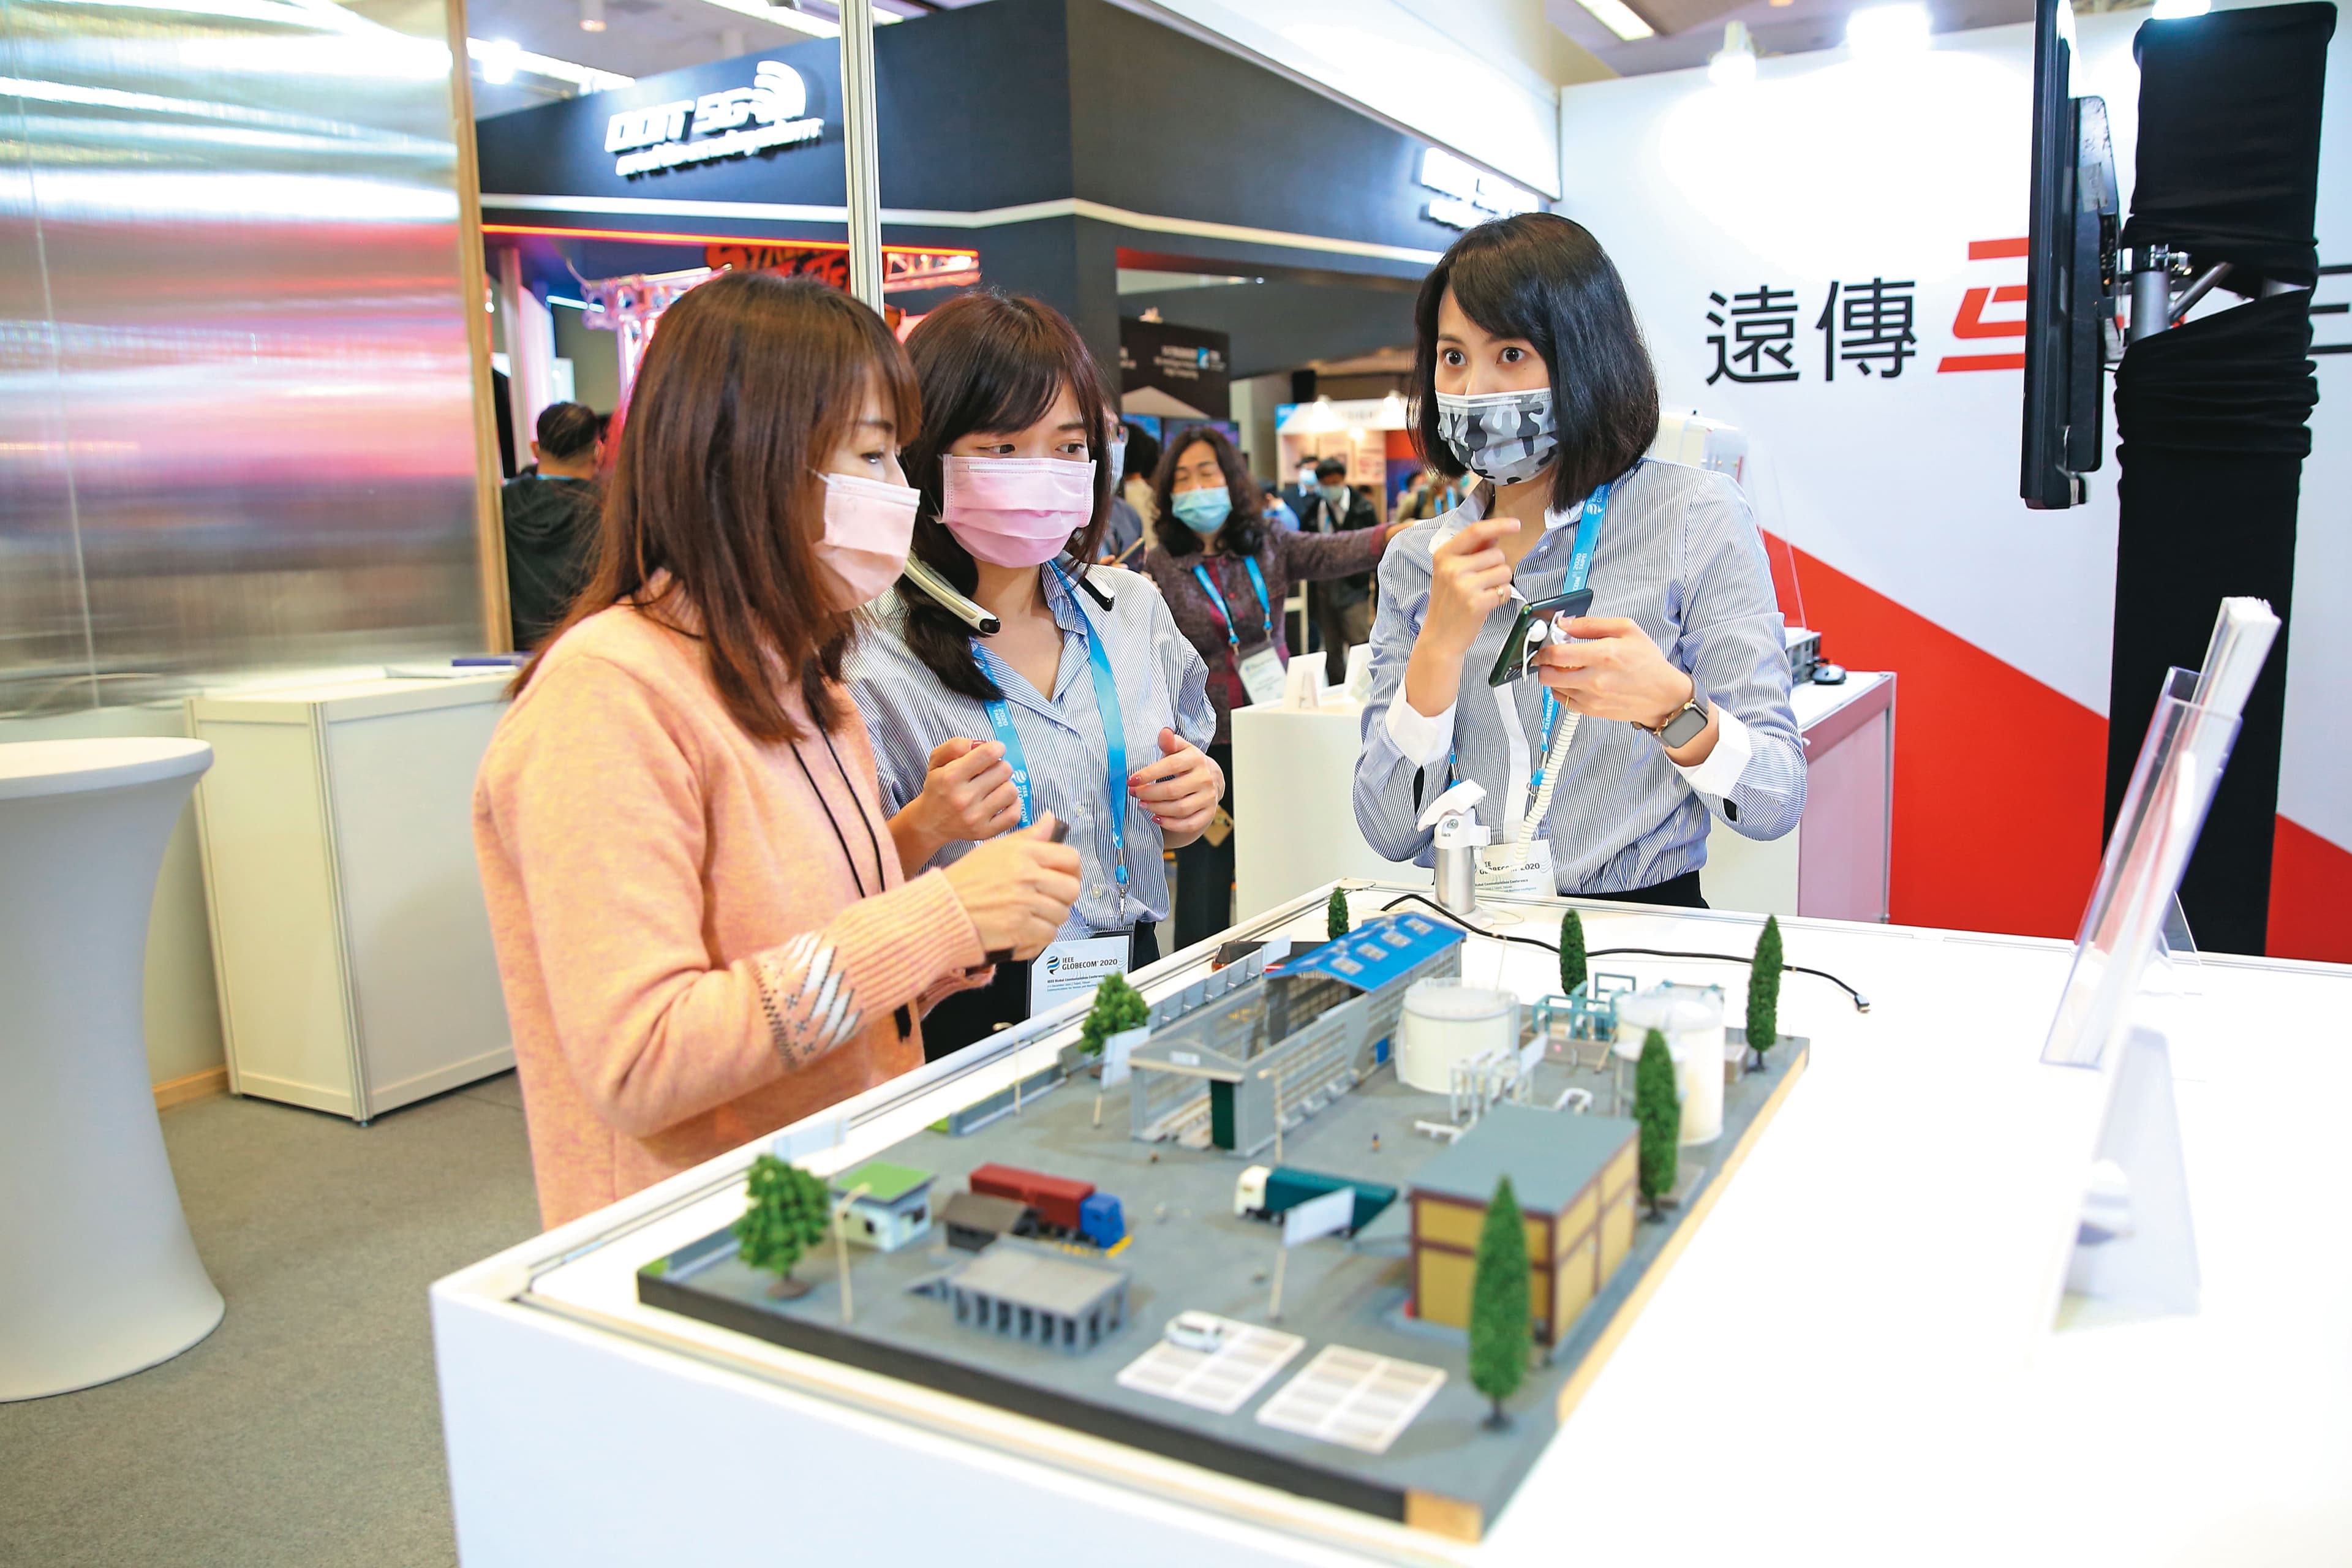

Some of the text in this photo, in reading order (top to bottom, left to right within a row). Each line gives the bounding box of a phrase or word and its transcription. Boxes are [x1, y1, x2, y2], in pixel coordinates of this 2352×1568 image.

[1705, 277, 1918, 386] 遠傳
[1572, 552, 1582, 570] 2020
[1578, 552, 1588, 570] TAIPEI
[993, 709, 1003, 728] TAIPEI
[997, 707, 1009, 726] 2020
[1520, 862, 1540, 871] 020
